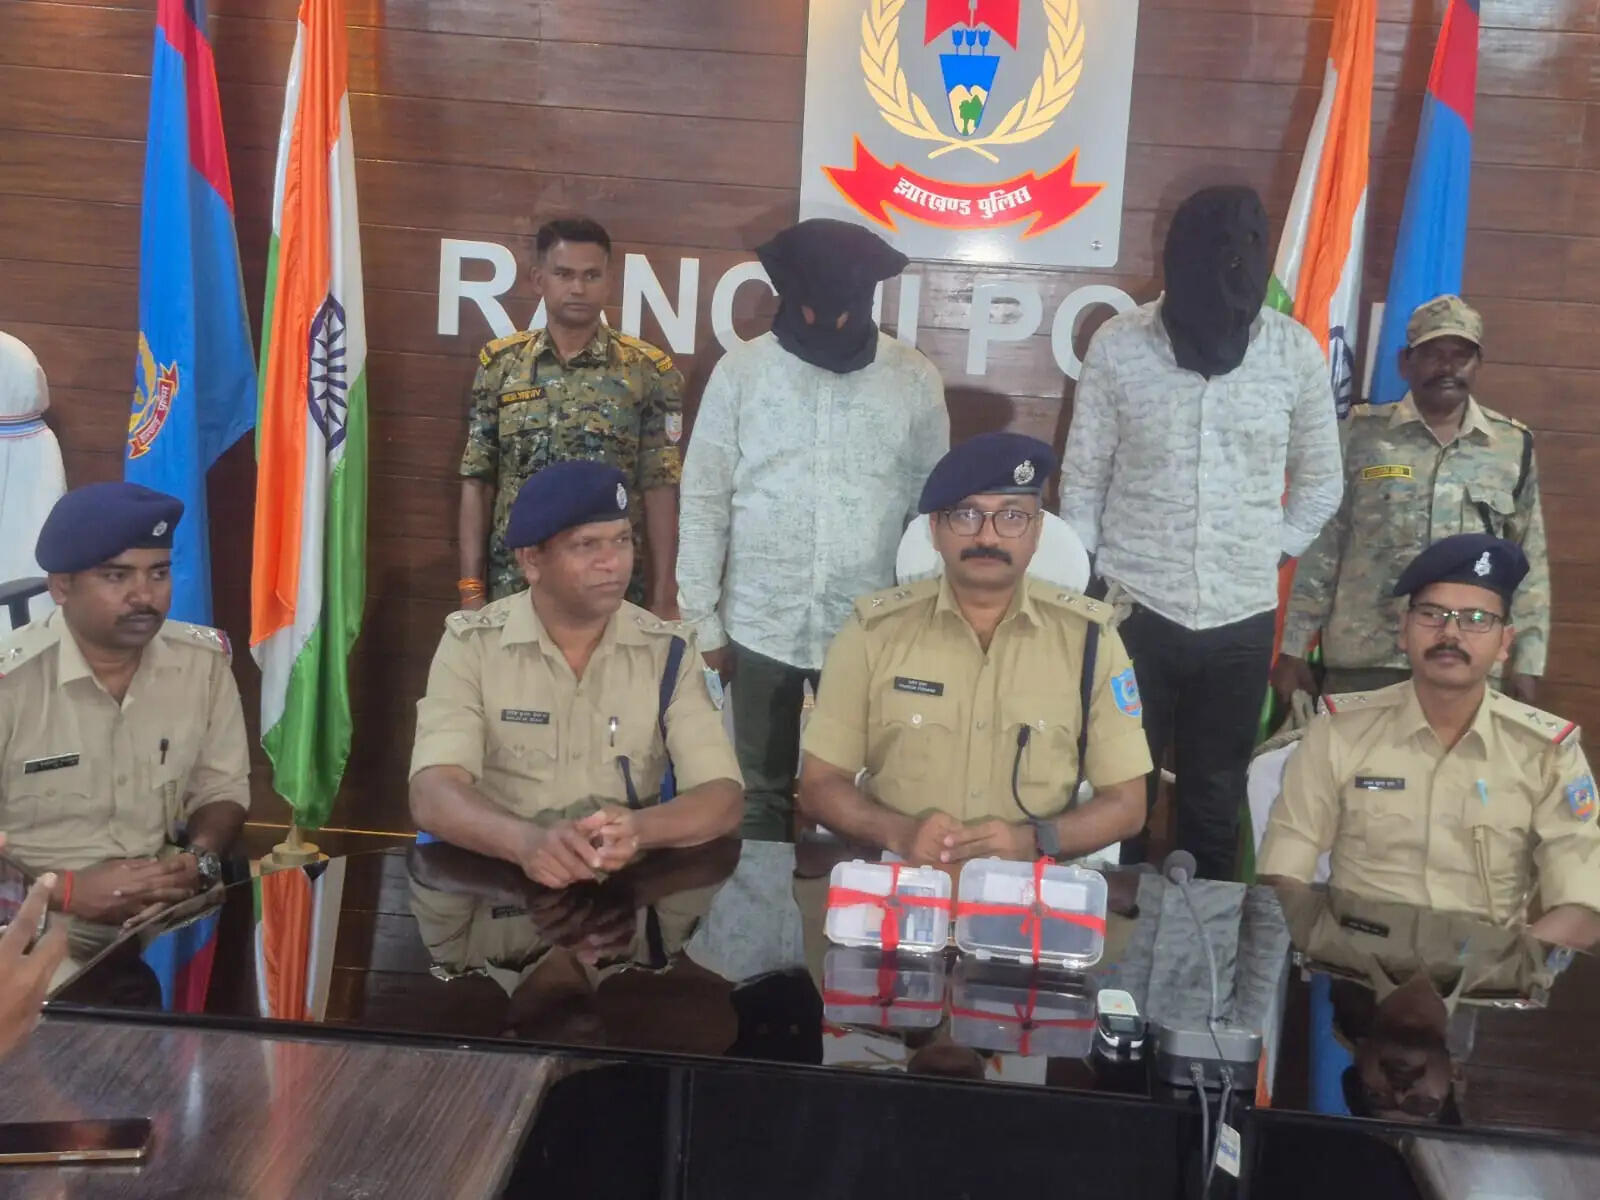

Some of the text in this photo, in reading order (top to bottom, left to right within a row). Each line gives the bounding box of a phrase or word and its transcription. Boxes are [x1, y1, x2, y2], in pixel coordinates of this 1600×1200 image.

[893, 176, 1033, 219] झारखण्ड पुलिस
[438, 238, 920, 354] RNCI
